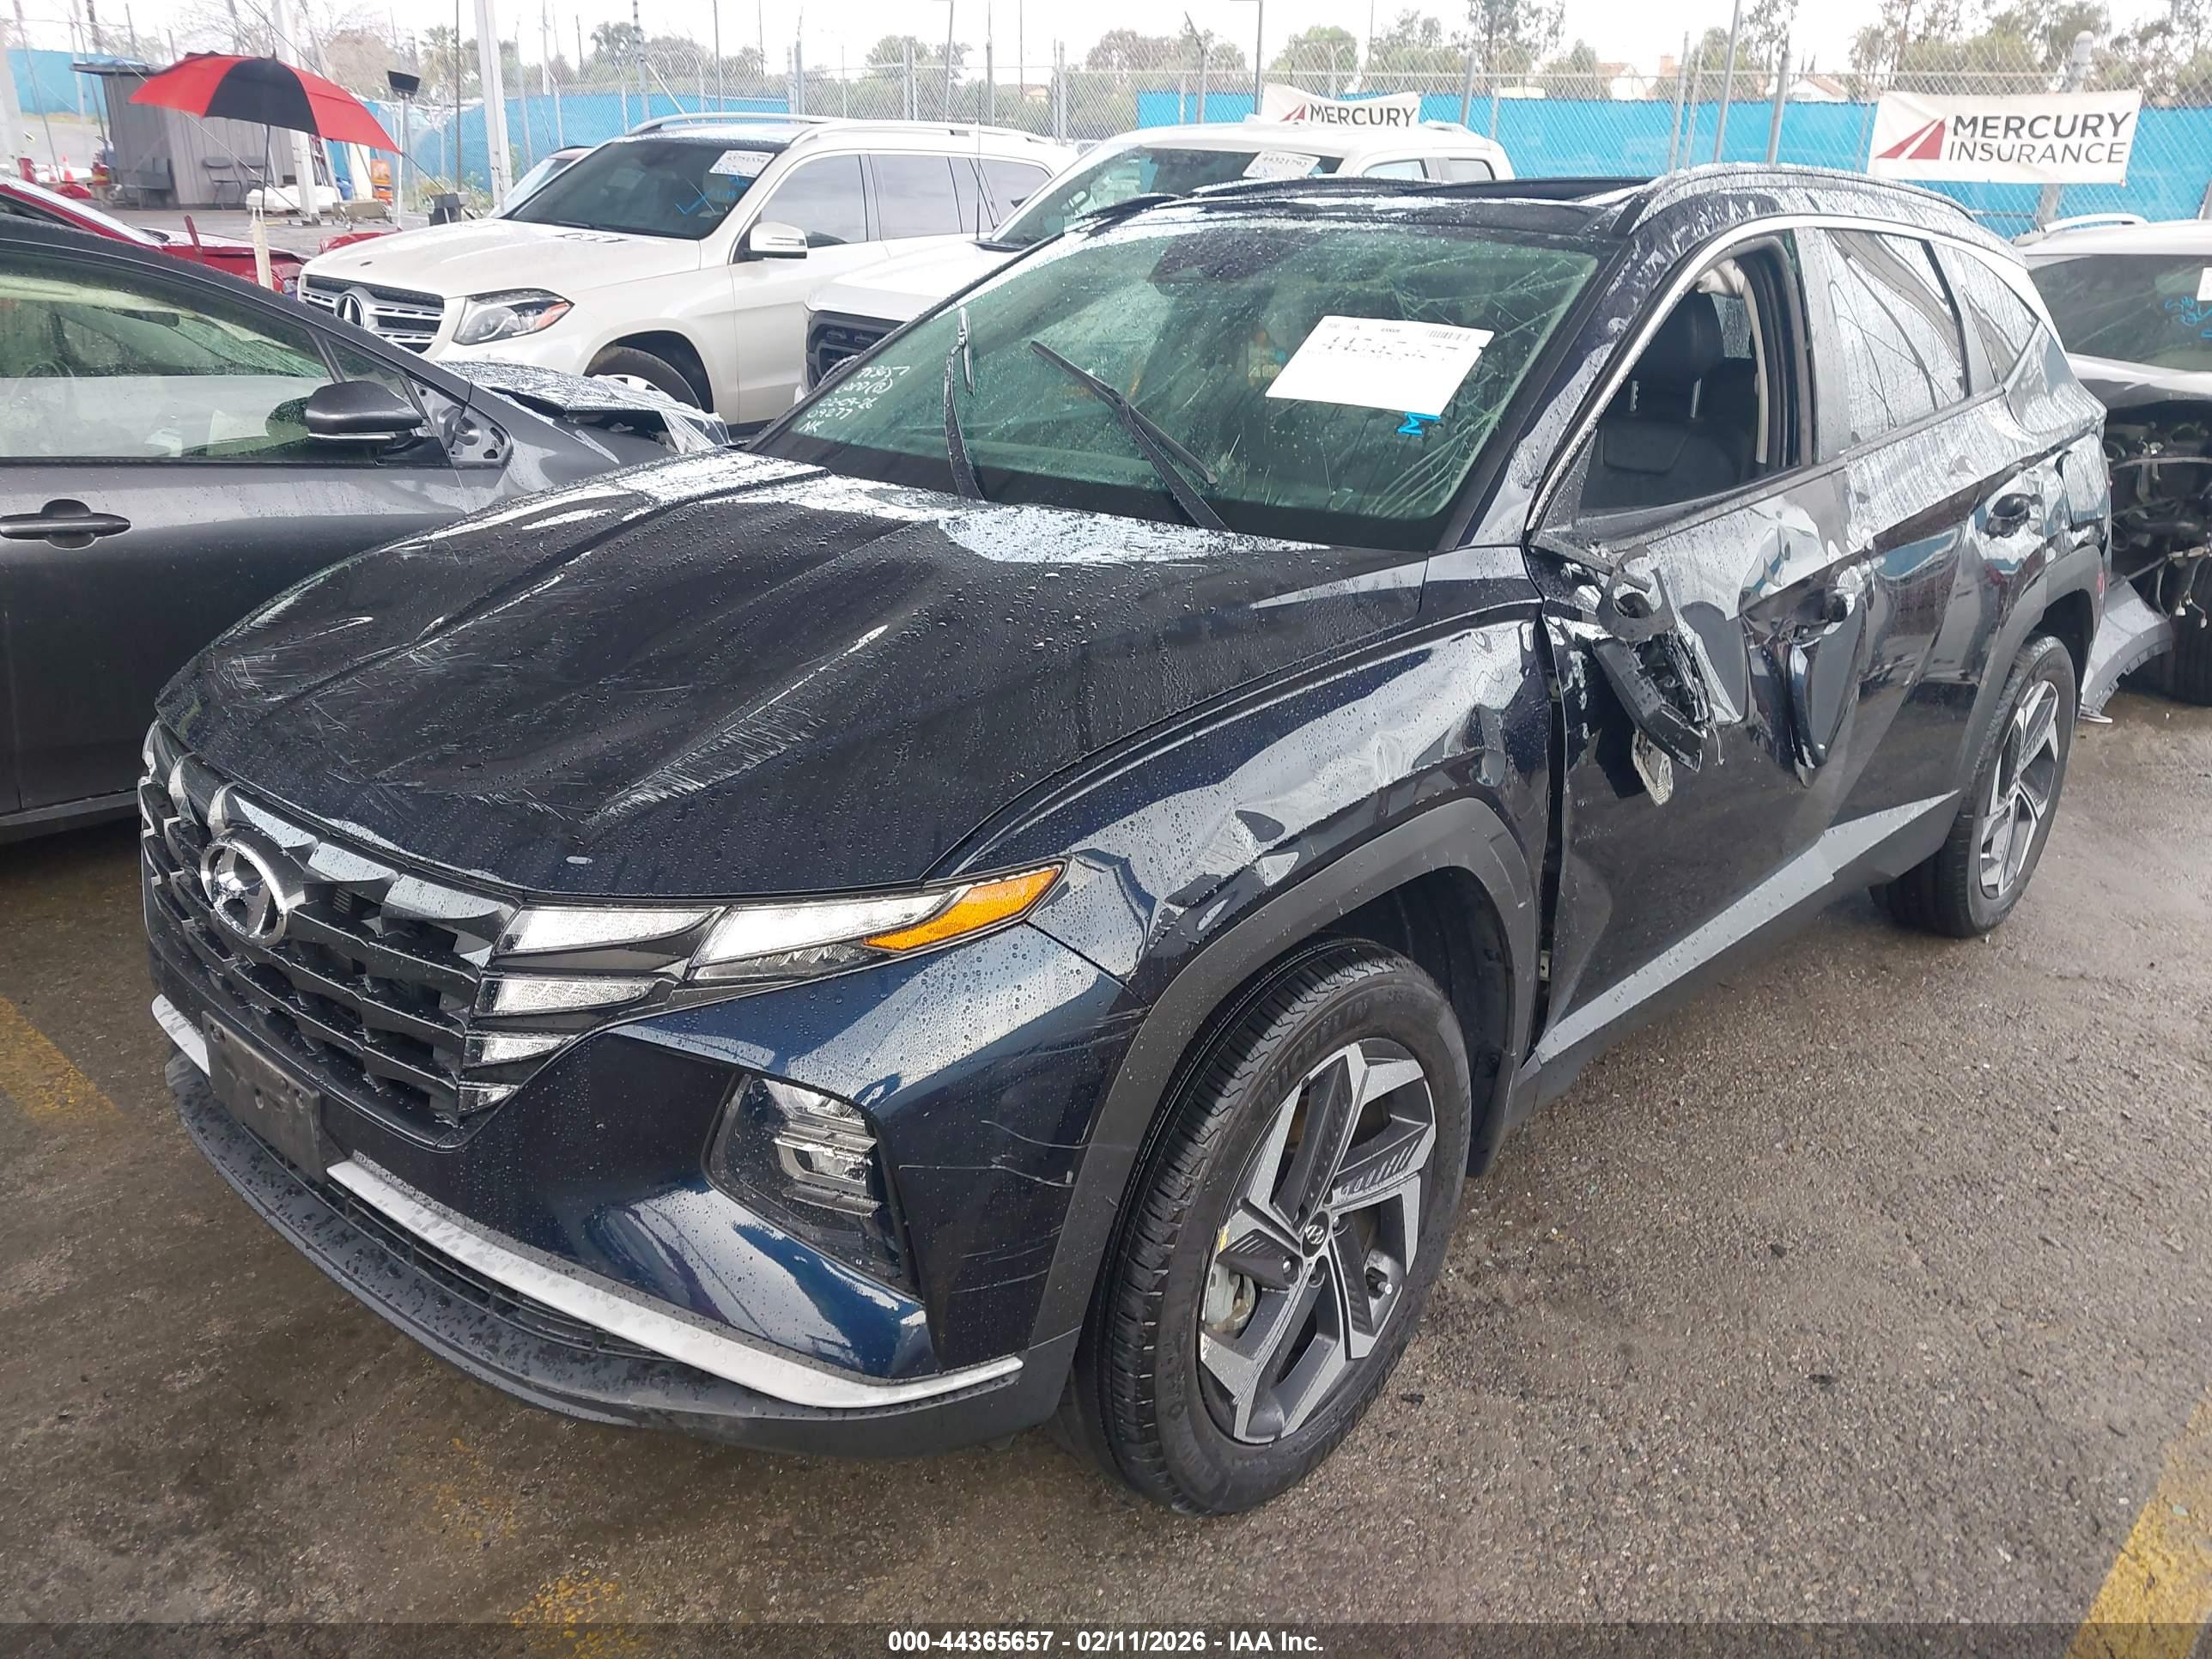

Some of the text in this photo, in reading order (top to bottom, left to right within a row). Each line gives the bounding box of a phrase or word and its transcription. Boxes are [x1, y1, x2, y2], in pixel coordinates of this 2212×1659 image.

[1310, 103, 1416, 128] MERCURY
[1952, 112, 2132, 139] MERCURY
[1948, 141, 2128, 164] INSURANCE
